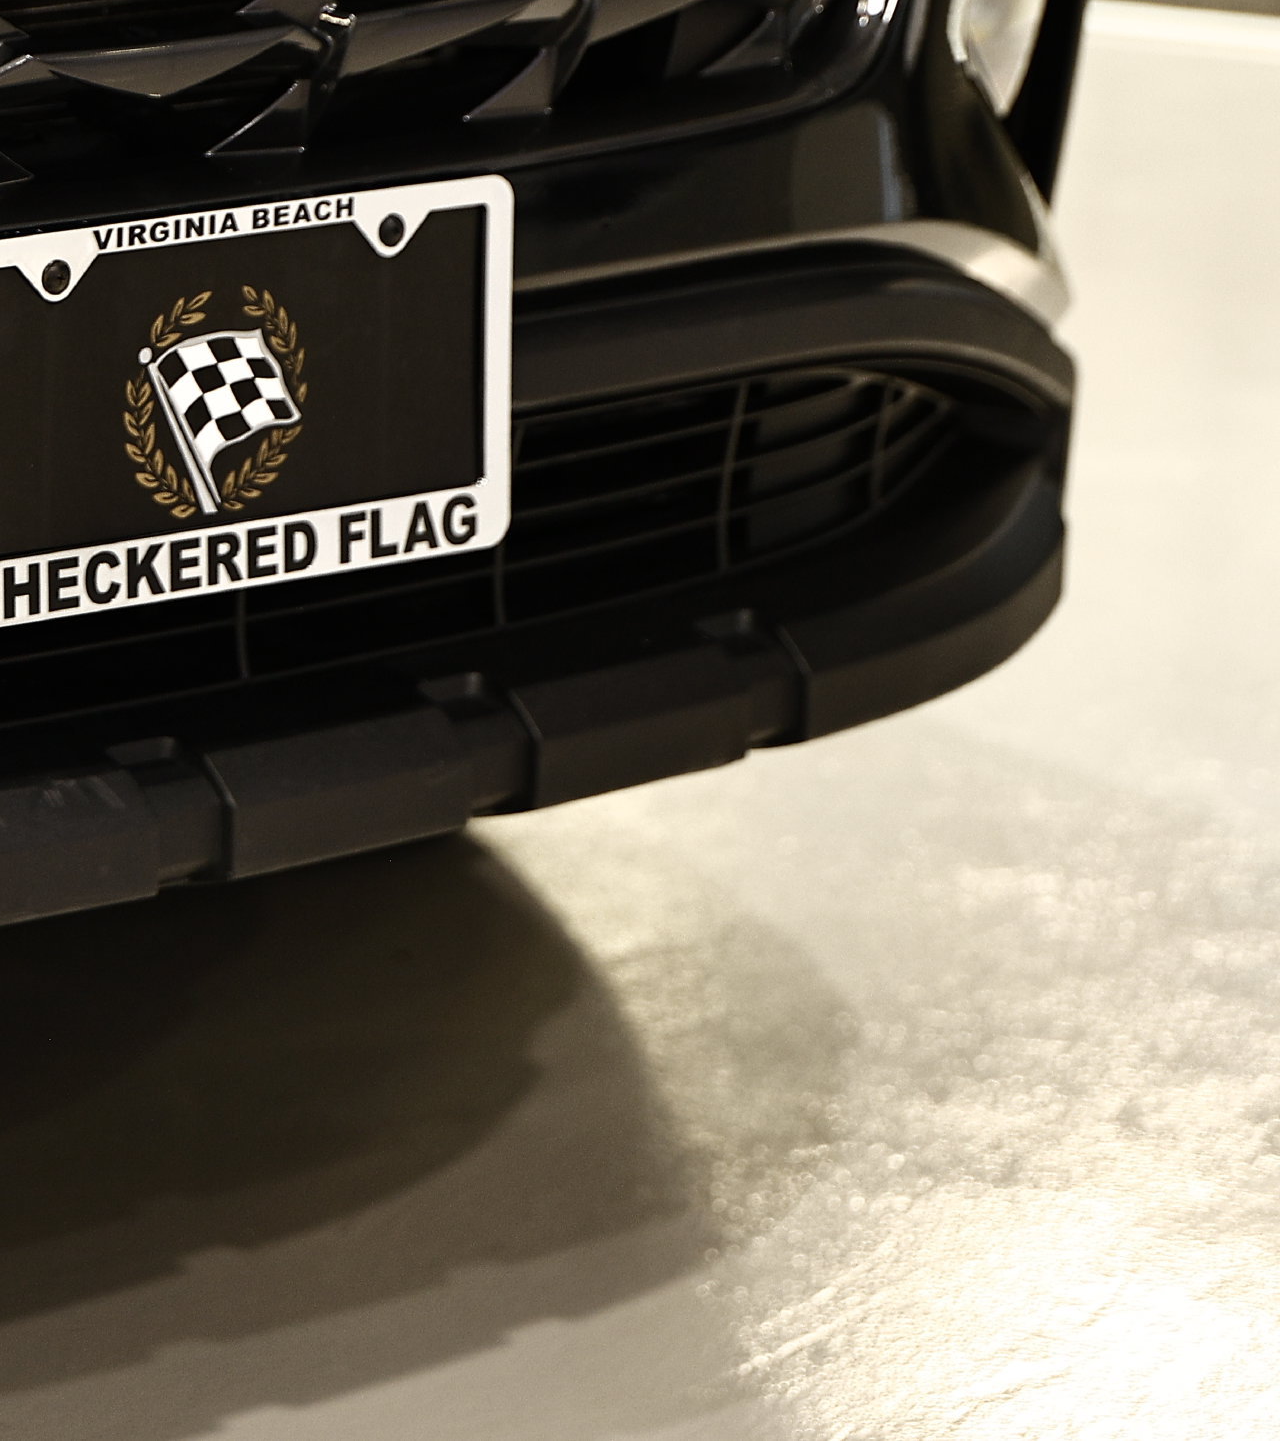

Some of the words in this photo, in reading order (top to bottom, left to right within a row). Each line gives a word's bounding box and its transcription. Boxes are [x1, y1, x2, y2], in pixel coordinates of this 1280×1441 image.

[92, 212, 239, 250] VIRGINIA
[252, 197, 354, 230] BEACH
[339, 495, 478, 566] FLAG
